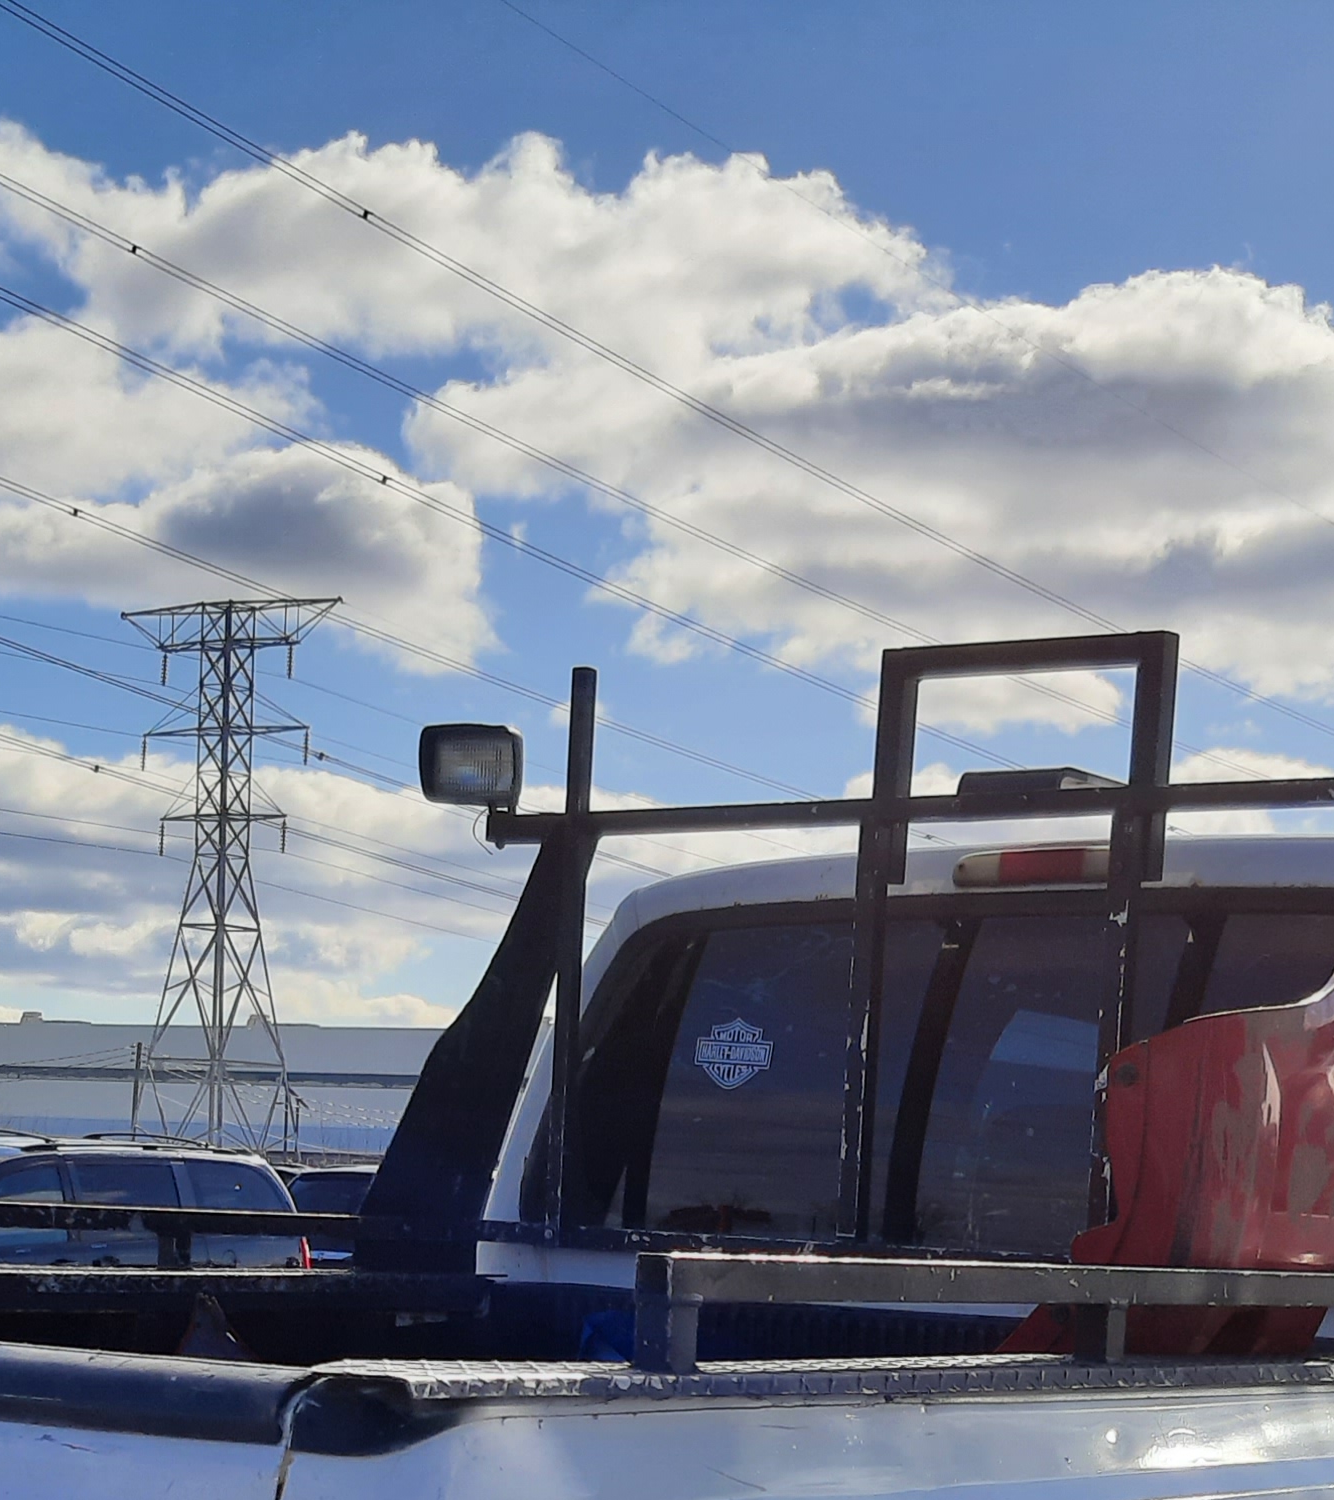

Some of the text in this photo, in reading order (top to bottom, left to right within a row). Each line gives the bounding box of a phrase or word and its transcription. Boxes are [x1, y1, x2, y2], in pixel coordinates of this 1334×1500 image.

[718, 1029, 755, 1043] MOTOR
[701, 1044, 766, 1063] HARLEY-DAVIDSON
[713, 1063, 749, 1081] CYCLES
